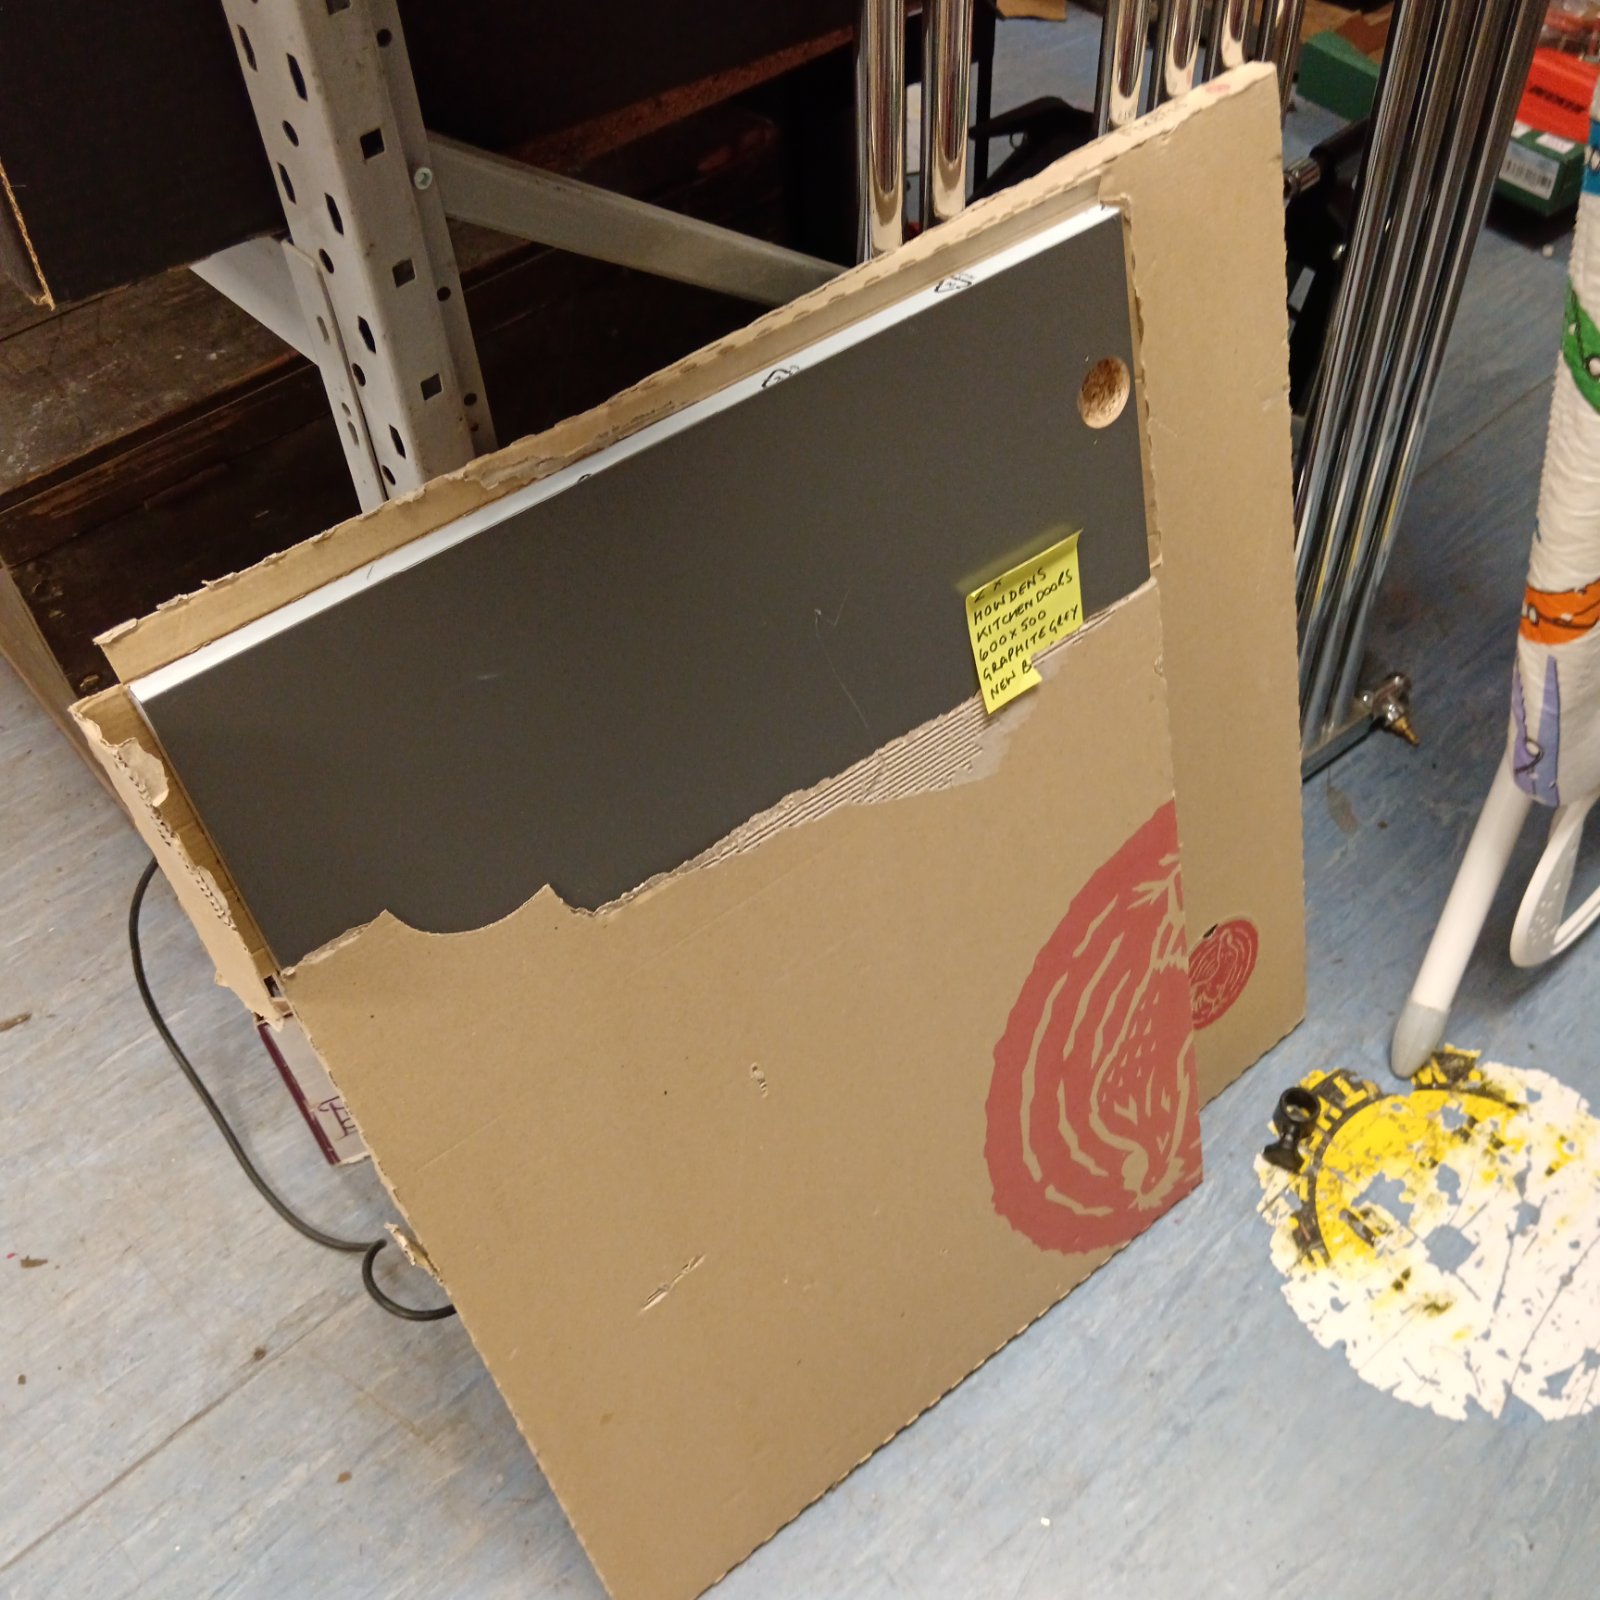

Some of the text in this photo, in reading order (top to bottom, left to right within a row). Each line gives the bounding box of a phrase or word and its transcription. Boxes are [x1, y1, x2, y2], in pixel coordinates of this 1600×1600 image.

[974, 567, 1047, 626] HOWDENS
[976, 568, 1073, 643] KITCHEN DOORS
[983, 604, 1079, 681] GRAPHITE GREY
[990, 669, 1016, 700] NEW
